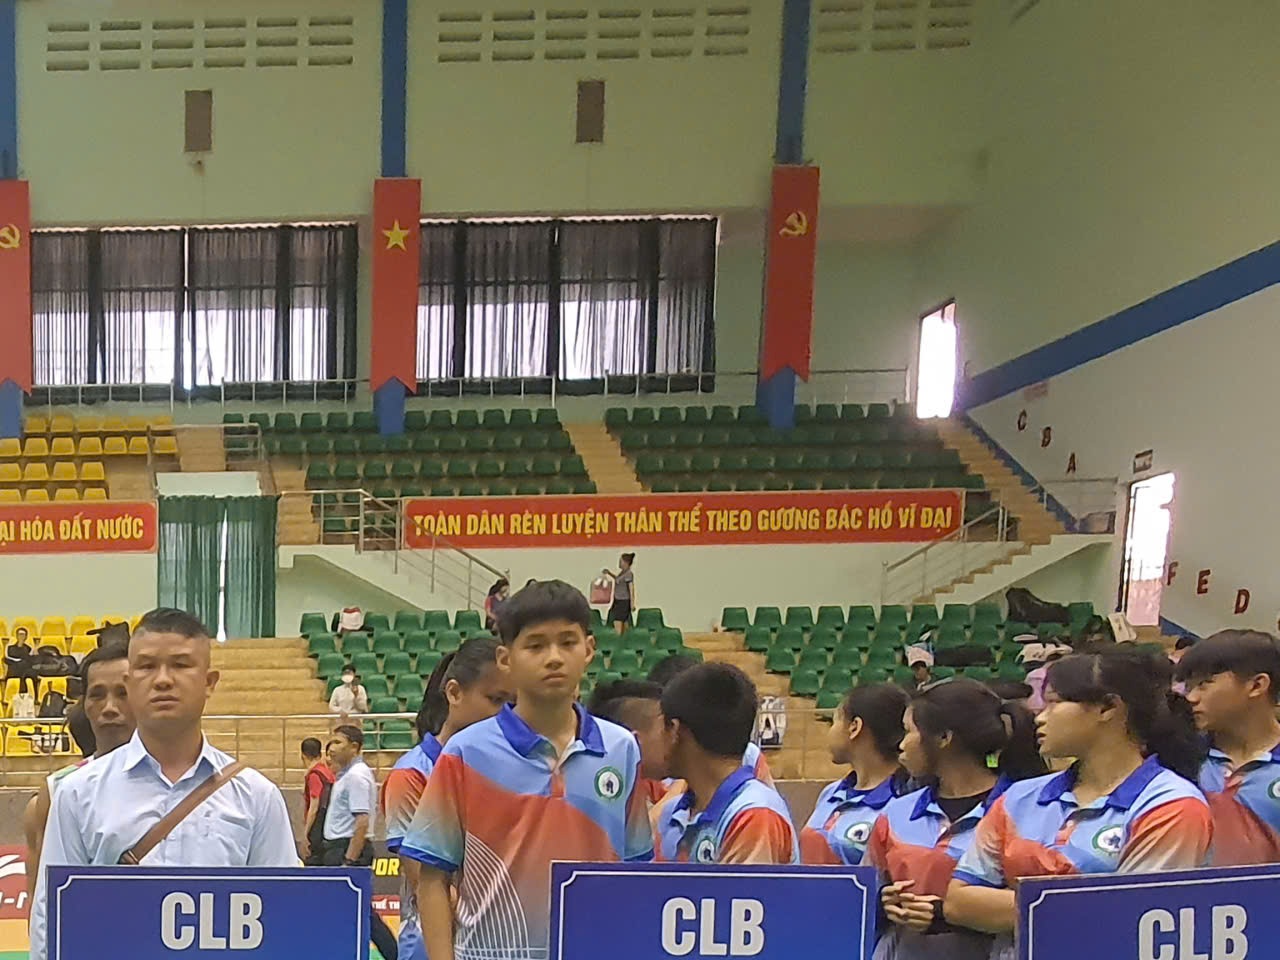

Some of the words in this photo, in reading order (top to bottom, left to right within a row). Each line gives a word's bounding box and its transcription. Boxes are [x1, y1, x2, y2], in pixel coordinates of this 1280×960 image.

[1017, 409, 1028, 431] C
[1066, 452, 1076, 474] A
[19, 515, 55, 541] HÓA
[96, 513, 144, 540] NƯỚC
[467, 509, 505, 536] DÂN
[552, 508, 609, 538] LUYỆN
[615, 507, 662, 533] THÂN
[707, 508, 752, 531] THEO
[757, 505, 820, 531] GƯƠNG
[825, 503, 863, 530] BÁC
[1166, 561, 1178, 586] F
[1197, 569, 1211, 594] E
[1234, 589, 1250, 614] D
[161, 891, 264, 950] CLB
[661, 897, 765, 956] CLB
